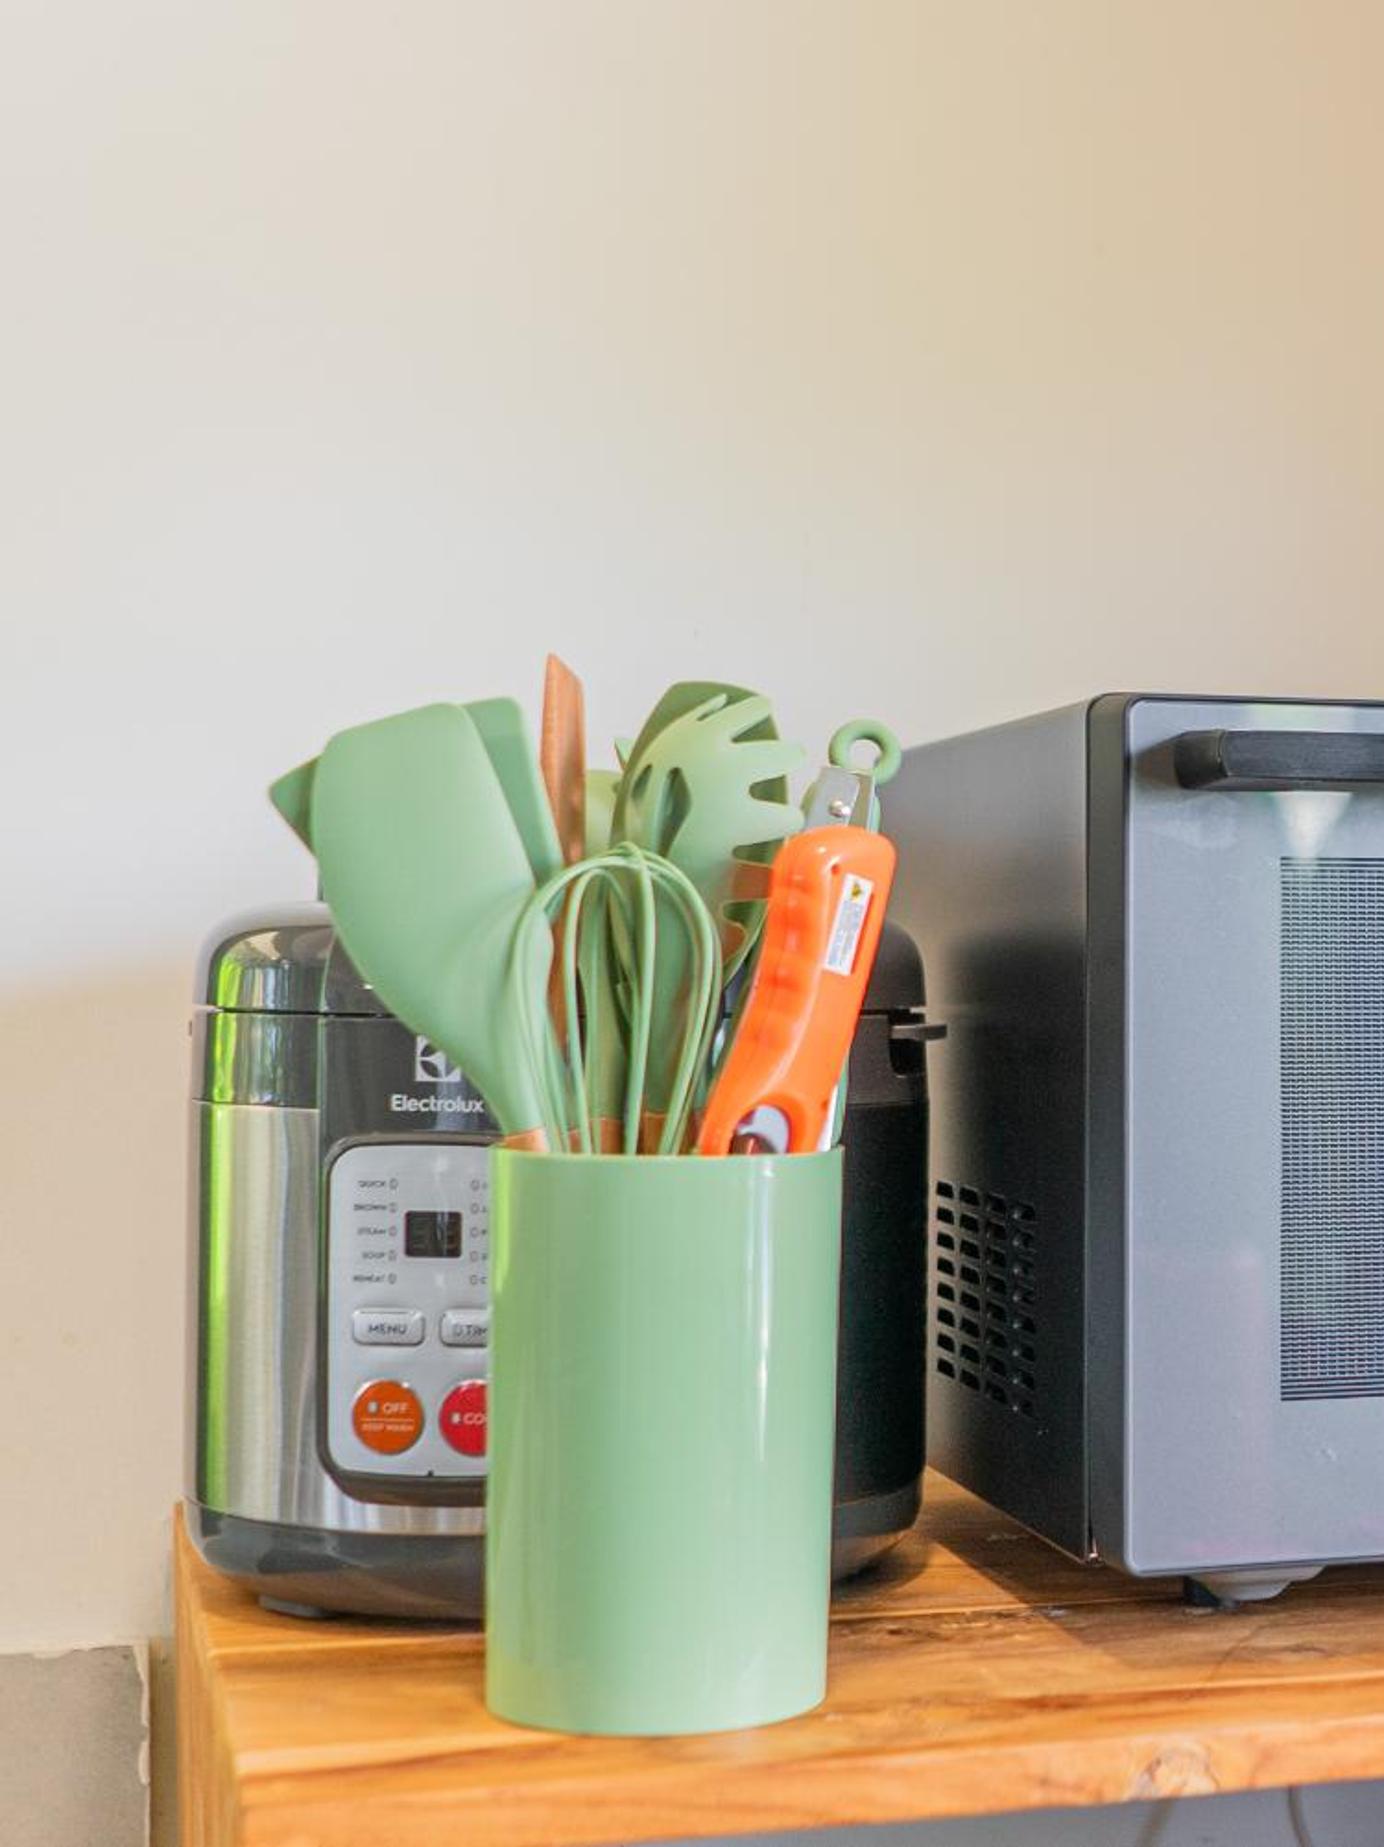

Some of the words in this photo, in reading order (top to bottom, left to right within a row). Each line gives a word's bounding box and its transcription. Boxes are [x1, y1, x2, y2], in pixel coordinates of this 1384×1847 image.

[391, 1093, 485, 1113] Electrolux
[367, 1323, 409, 1335] MENU
[466, 1324, 487, 1336] TIM
[382, 1401, 408, 1414] OFF
[462, 1412, 485, 1426] CO
